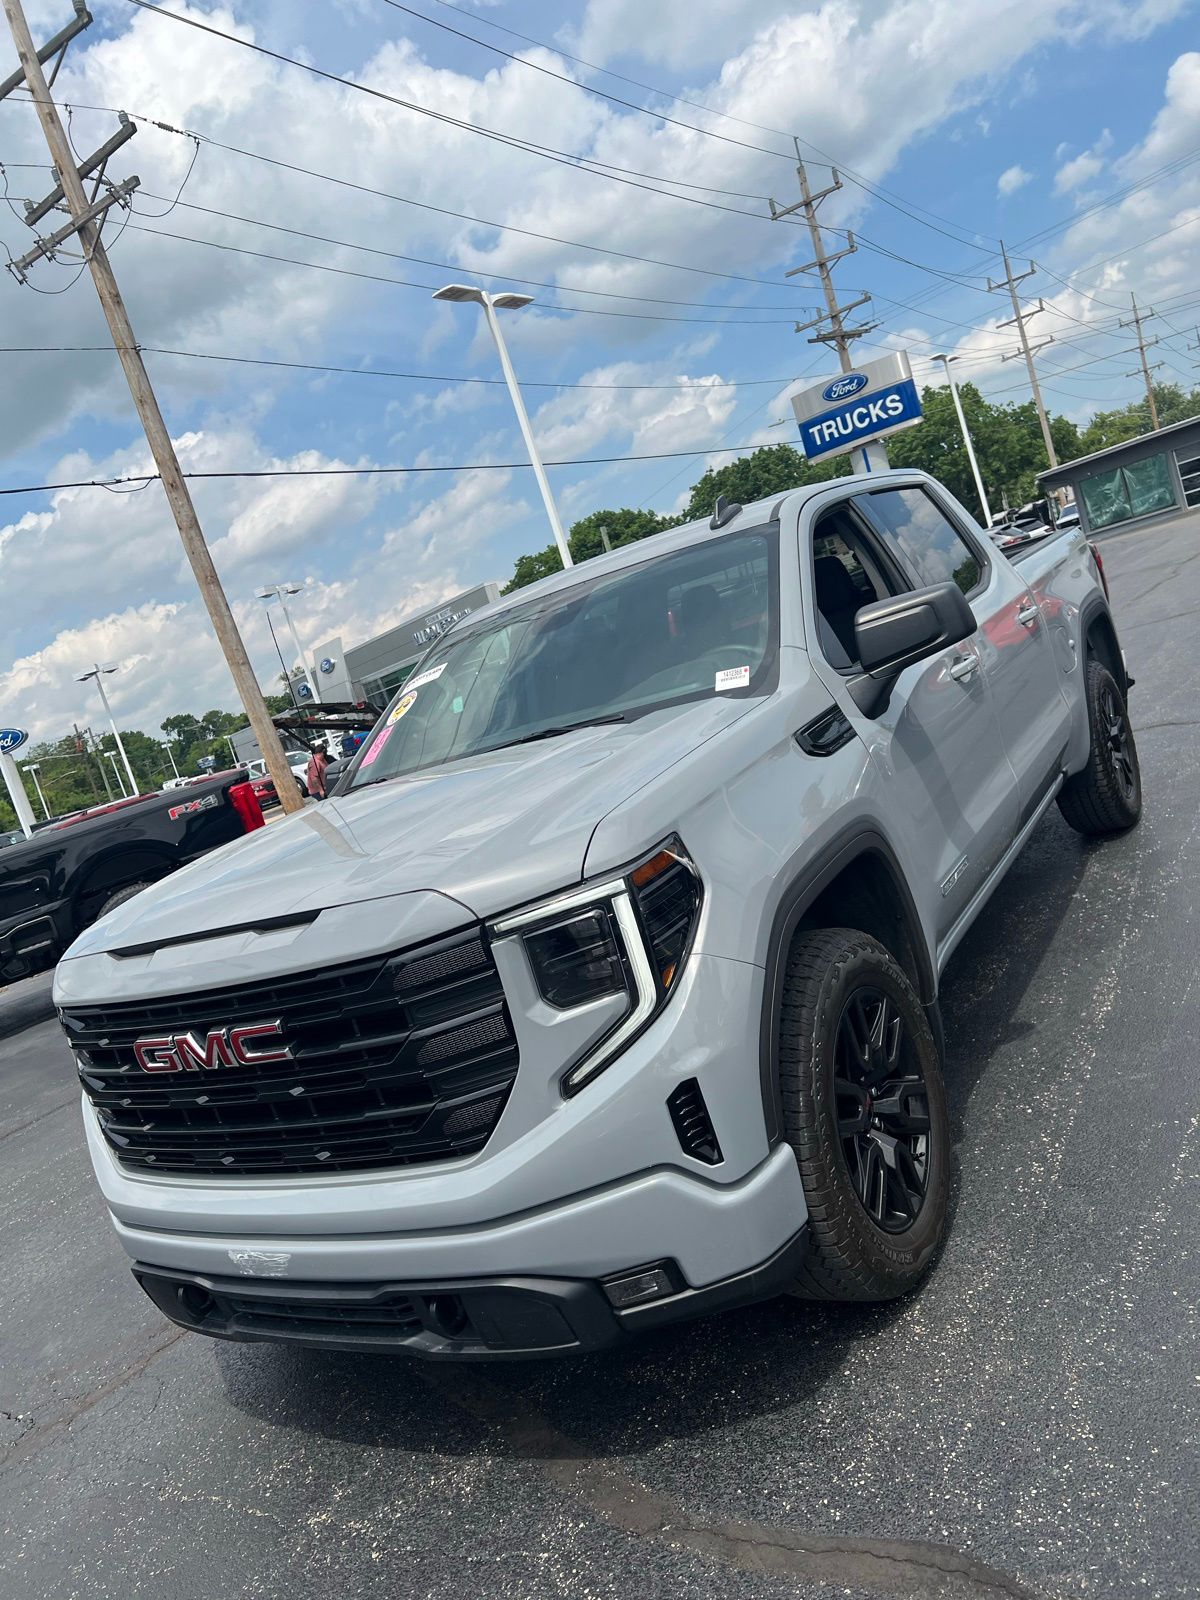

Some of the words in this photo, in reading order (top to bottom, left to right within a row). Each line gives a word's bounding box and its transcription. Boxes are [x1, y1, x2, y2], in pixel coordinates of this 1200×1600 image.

[831, 379, 858, 398] Ford
[809, 394, 904, 446] TRUCKS
[168, 794, 219, 821] FX4
[133, 1017, 294, 1074] GMC
